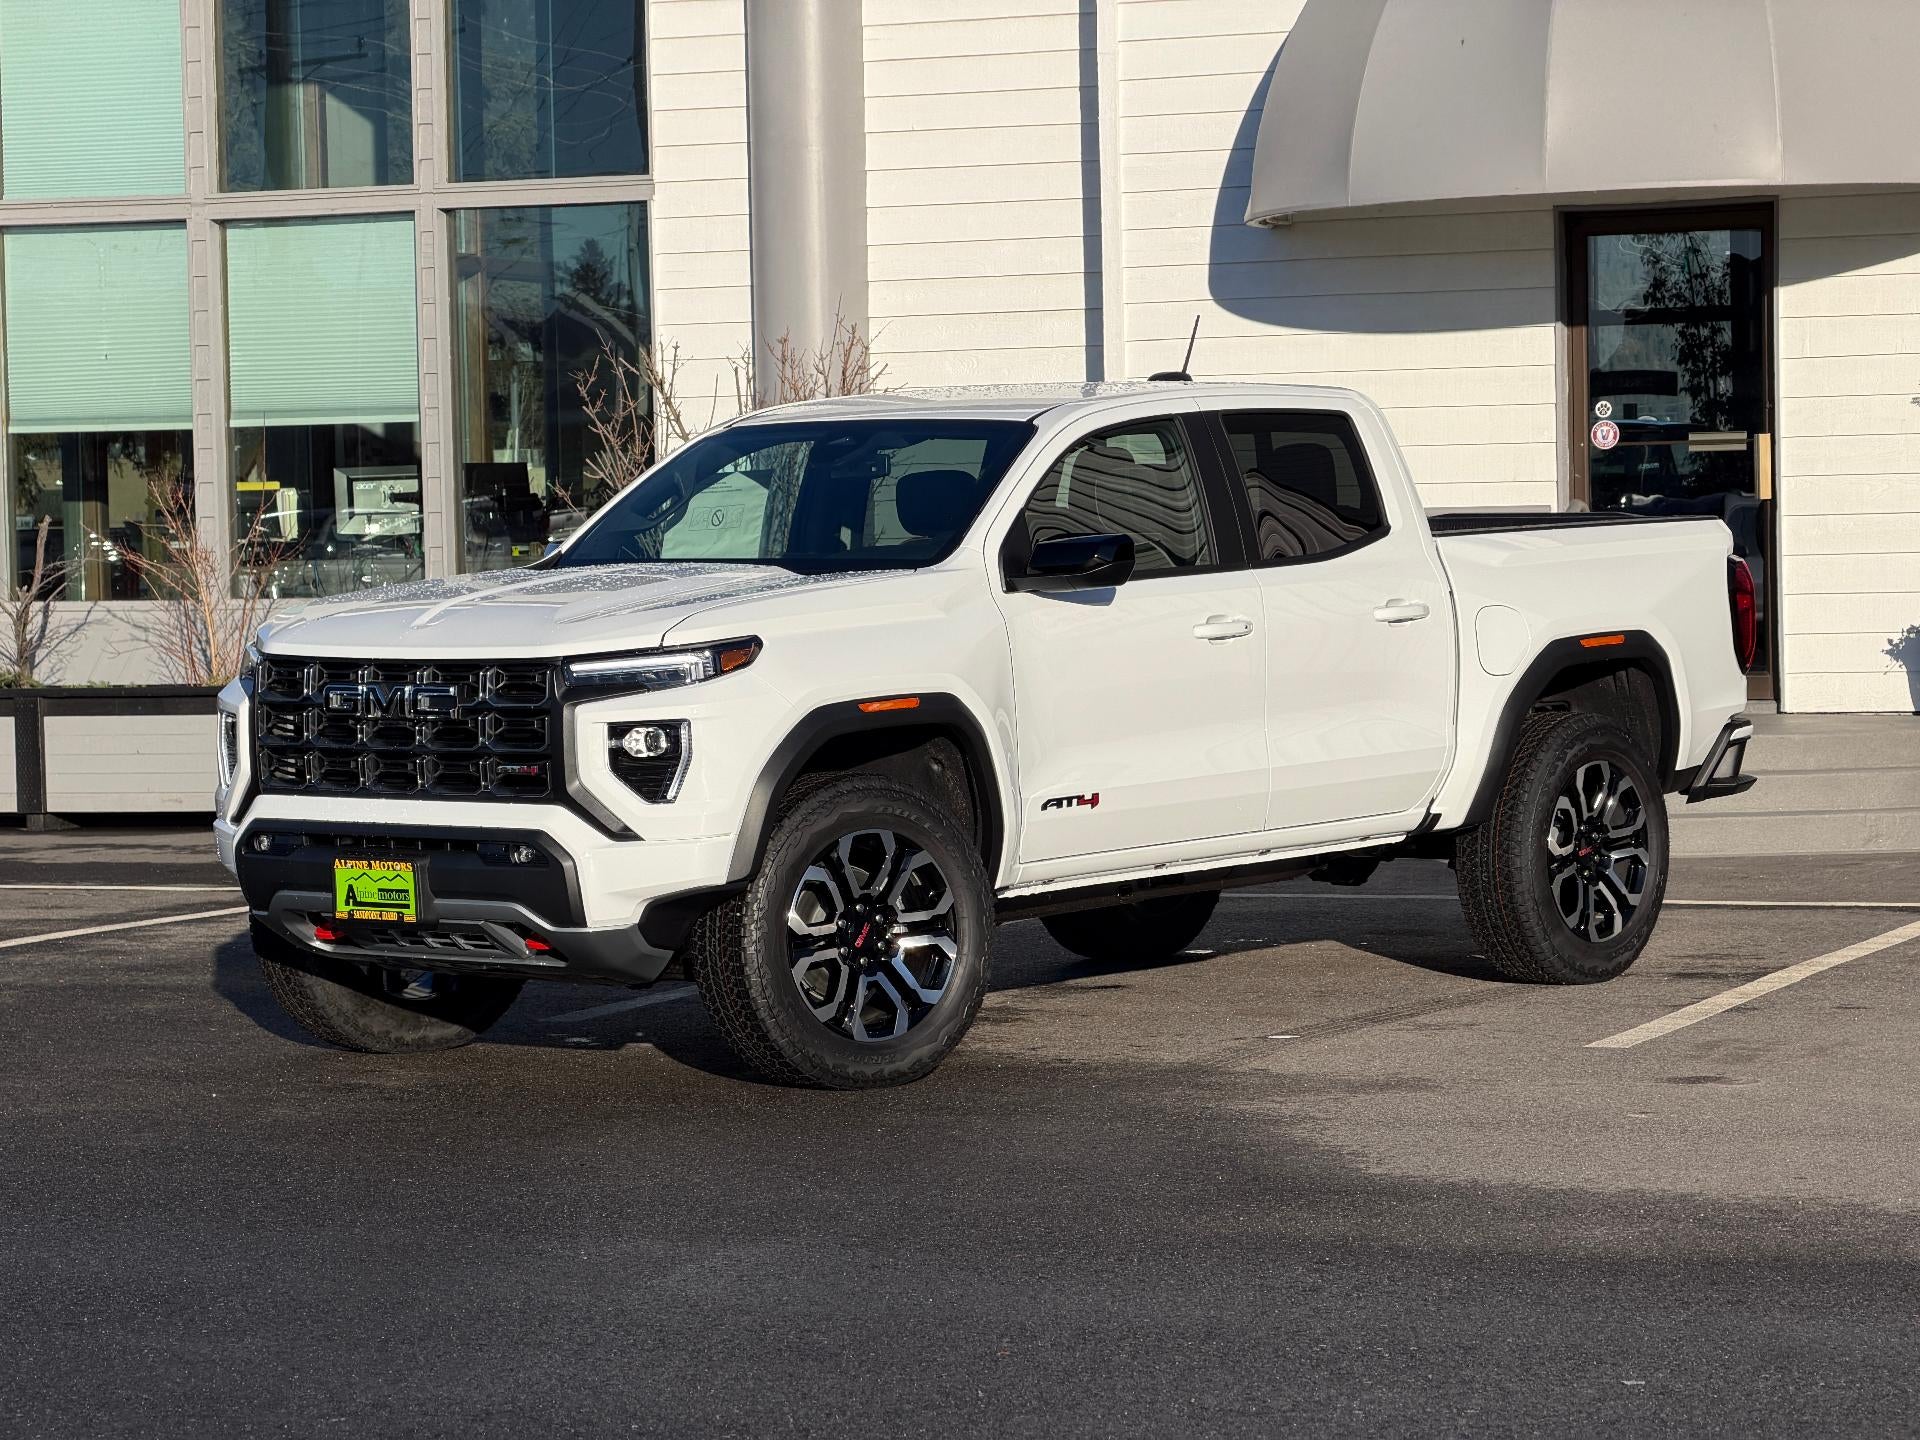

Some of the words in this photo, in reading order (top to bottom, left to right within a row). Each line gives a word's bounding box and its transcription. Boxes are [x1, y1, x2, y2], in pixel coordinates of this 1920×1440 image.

[356, 482, 376, 490] acer
[323, 684, 458, 719] GMC
[1040, 792, 1100, 811] AT4
[334, 858, 370, 870] ALPINE
[371, 860, 413, 872] MOTORS
[345, 884, 378, 906] Alpine
[378, 890, 410, 901] motors
[382, 911, 398, 920] IDAHO
[854, 922, 871, 948] GMC
